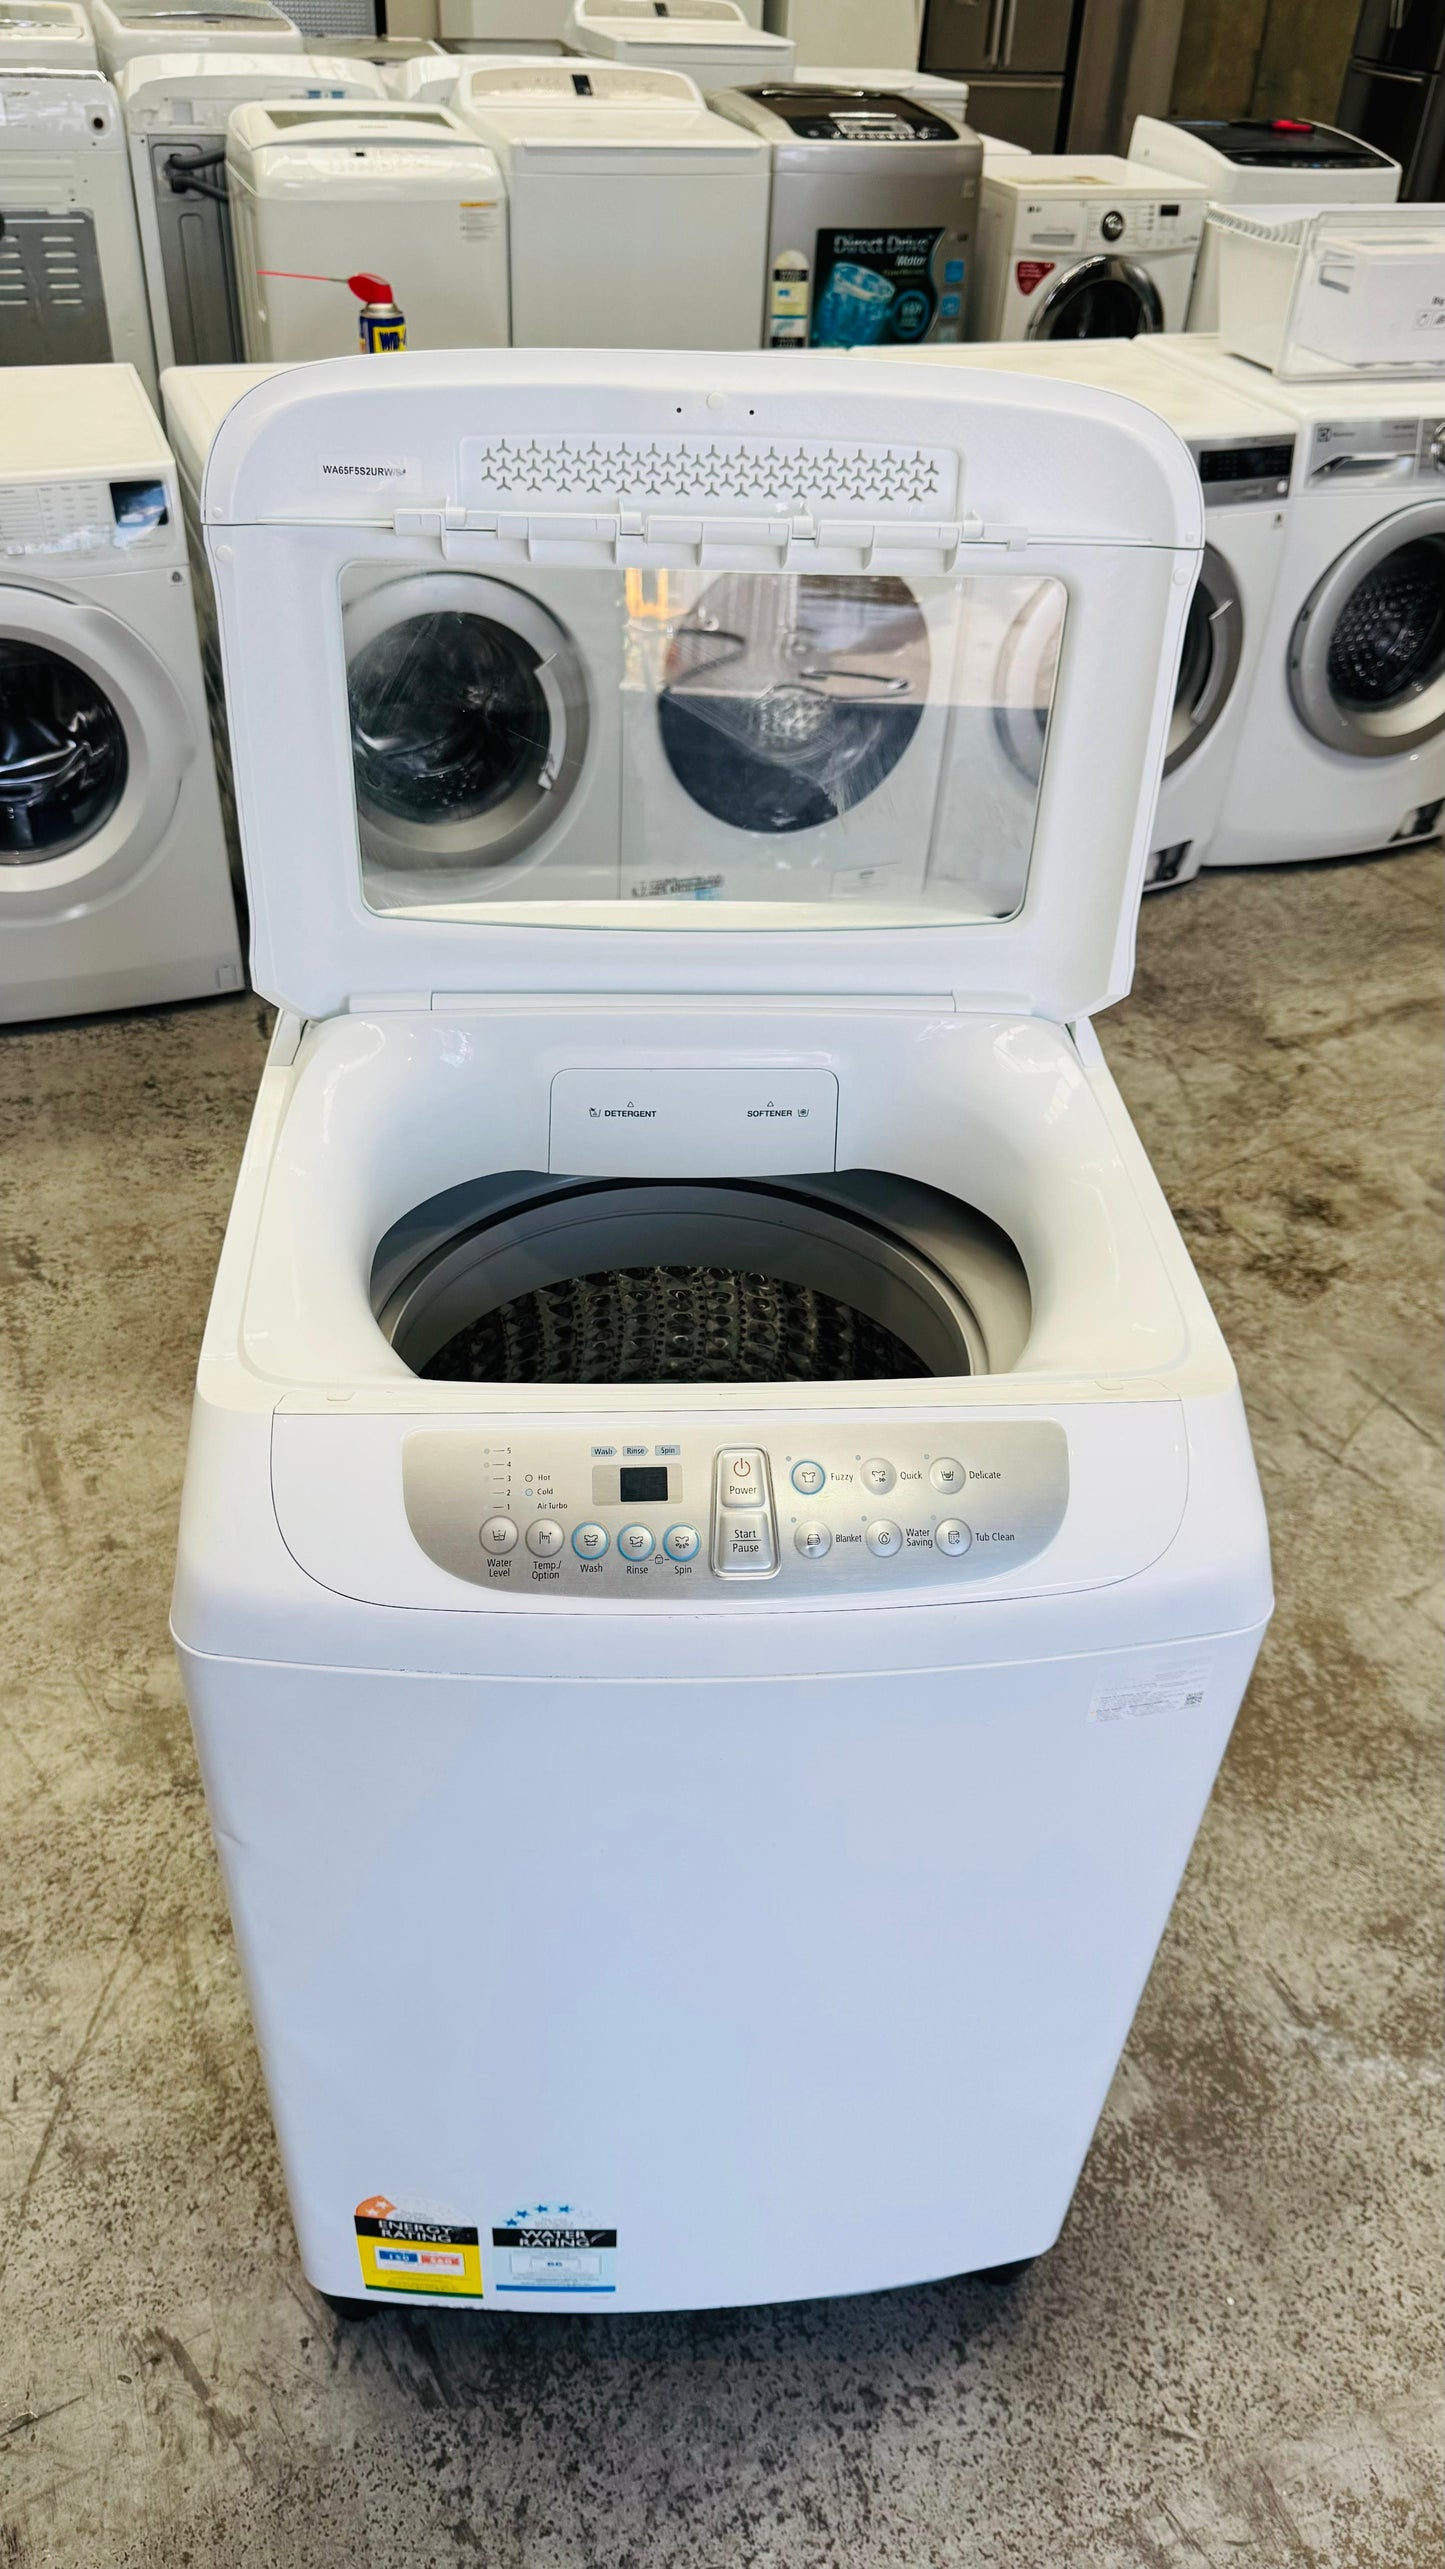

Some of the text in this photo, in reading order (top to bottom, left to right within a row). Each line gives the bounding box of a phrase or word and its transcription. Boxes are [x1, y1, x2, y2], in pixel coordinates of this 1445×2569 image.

[834, 235, 929, 254] Direct Drive
[895, 255, 928, 266] Motor
[604, 1109, 657, 1118] DETERGENT
[747, 1109, 793, 1118] SOFTENER
[593, 1447, 613, 1456] Wash
[626, 1446, 645, 1455] Rinse
[660, 1446, 676, 1456] Spin
[830, 1472, 854, 1484] Fuzzy
[900, 1470, 923, 1481] Quick
[969, 1470, 1001, 1480] Delicate
[729, 1484, 757, 1495] Power
[537, 1502, 568, 1510] Air Turbo
[734, 1528, 757, 1539] Start
[835, 1533, 862, 1543] Blanket
[905, 1528, 930, 1538] Water
[975, 1531, 1015, 1542] Tub Clean
[906, 1537, 933, 1548] Saving
[732, 1543, 759, 1553] Pause
[487, 1558, 512, 1568] Water
[532, 1560, 562, 1571] Temp./
[580, 1563, 603, 1573] Wash
[489, 1568, 511, 1577] Level
[626, 1565, 649, 1574] Rinse
[674, 1564, 692, 1576] Spin
[531, 1570, 560, 1581] Option
[378, 2219, 453, 2235] ENERGY
[381, 2229, 451, 2243] RATING
[521, 2229, 588, 2239] WATER
[519, 2238, 592, 2248] RATING
